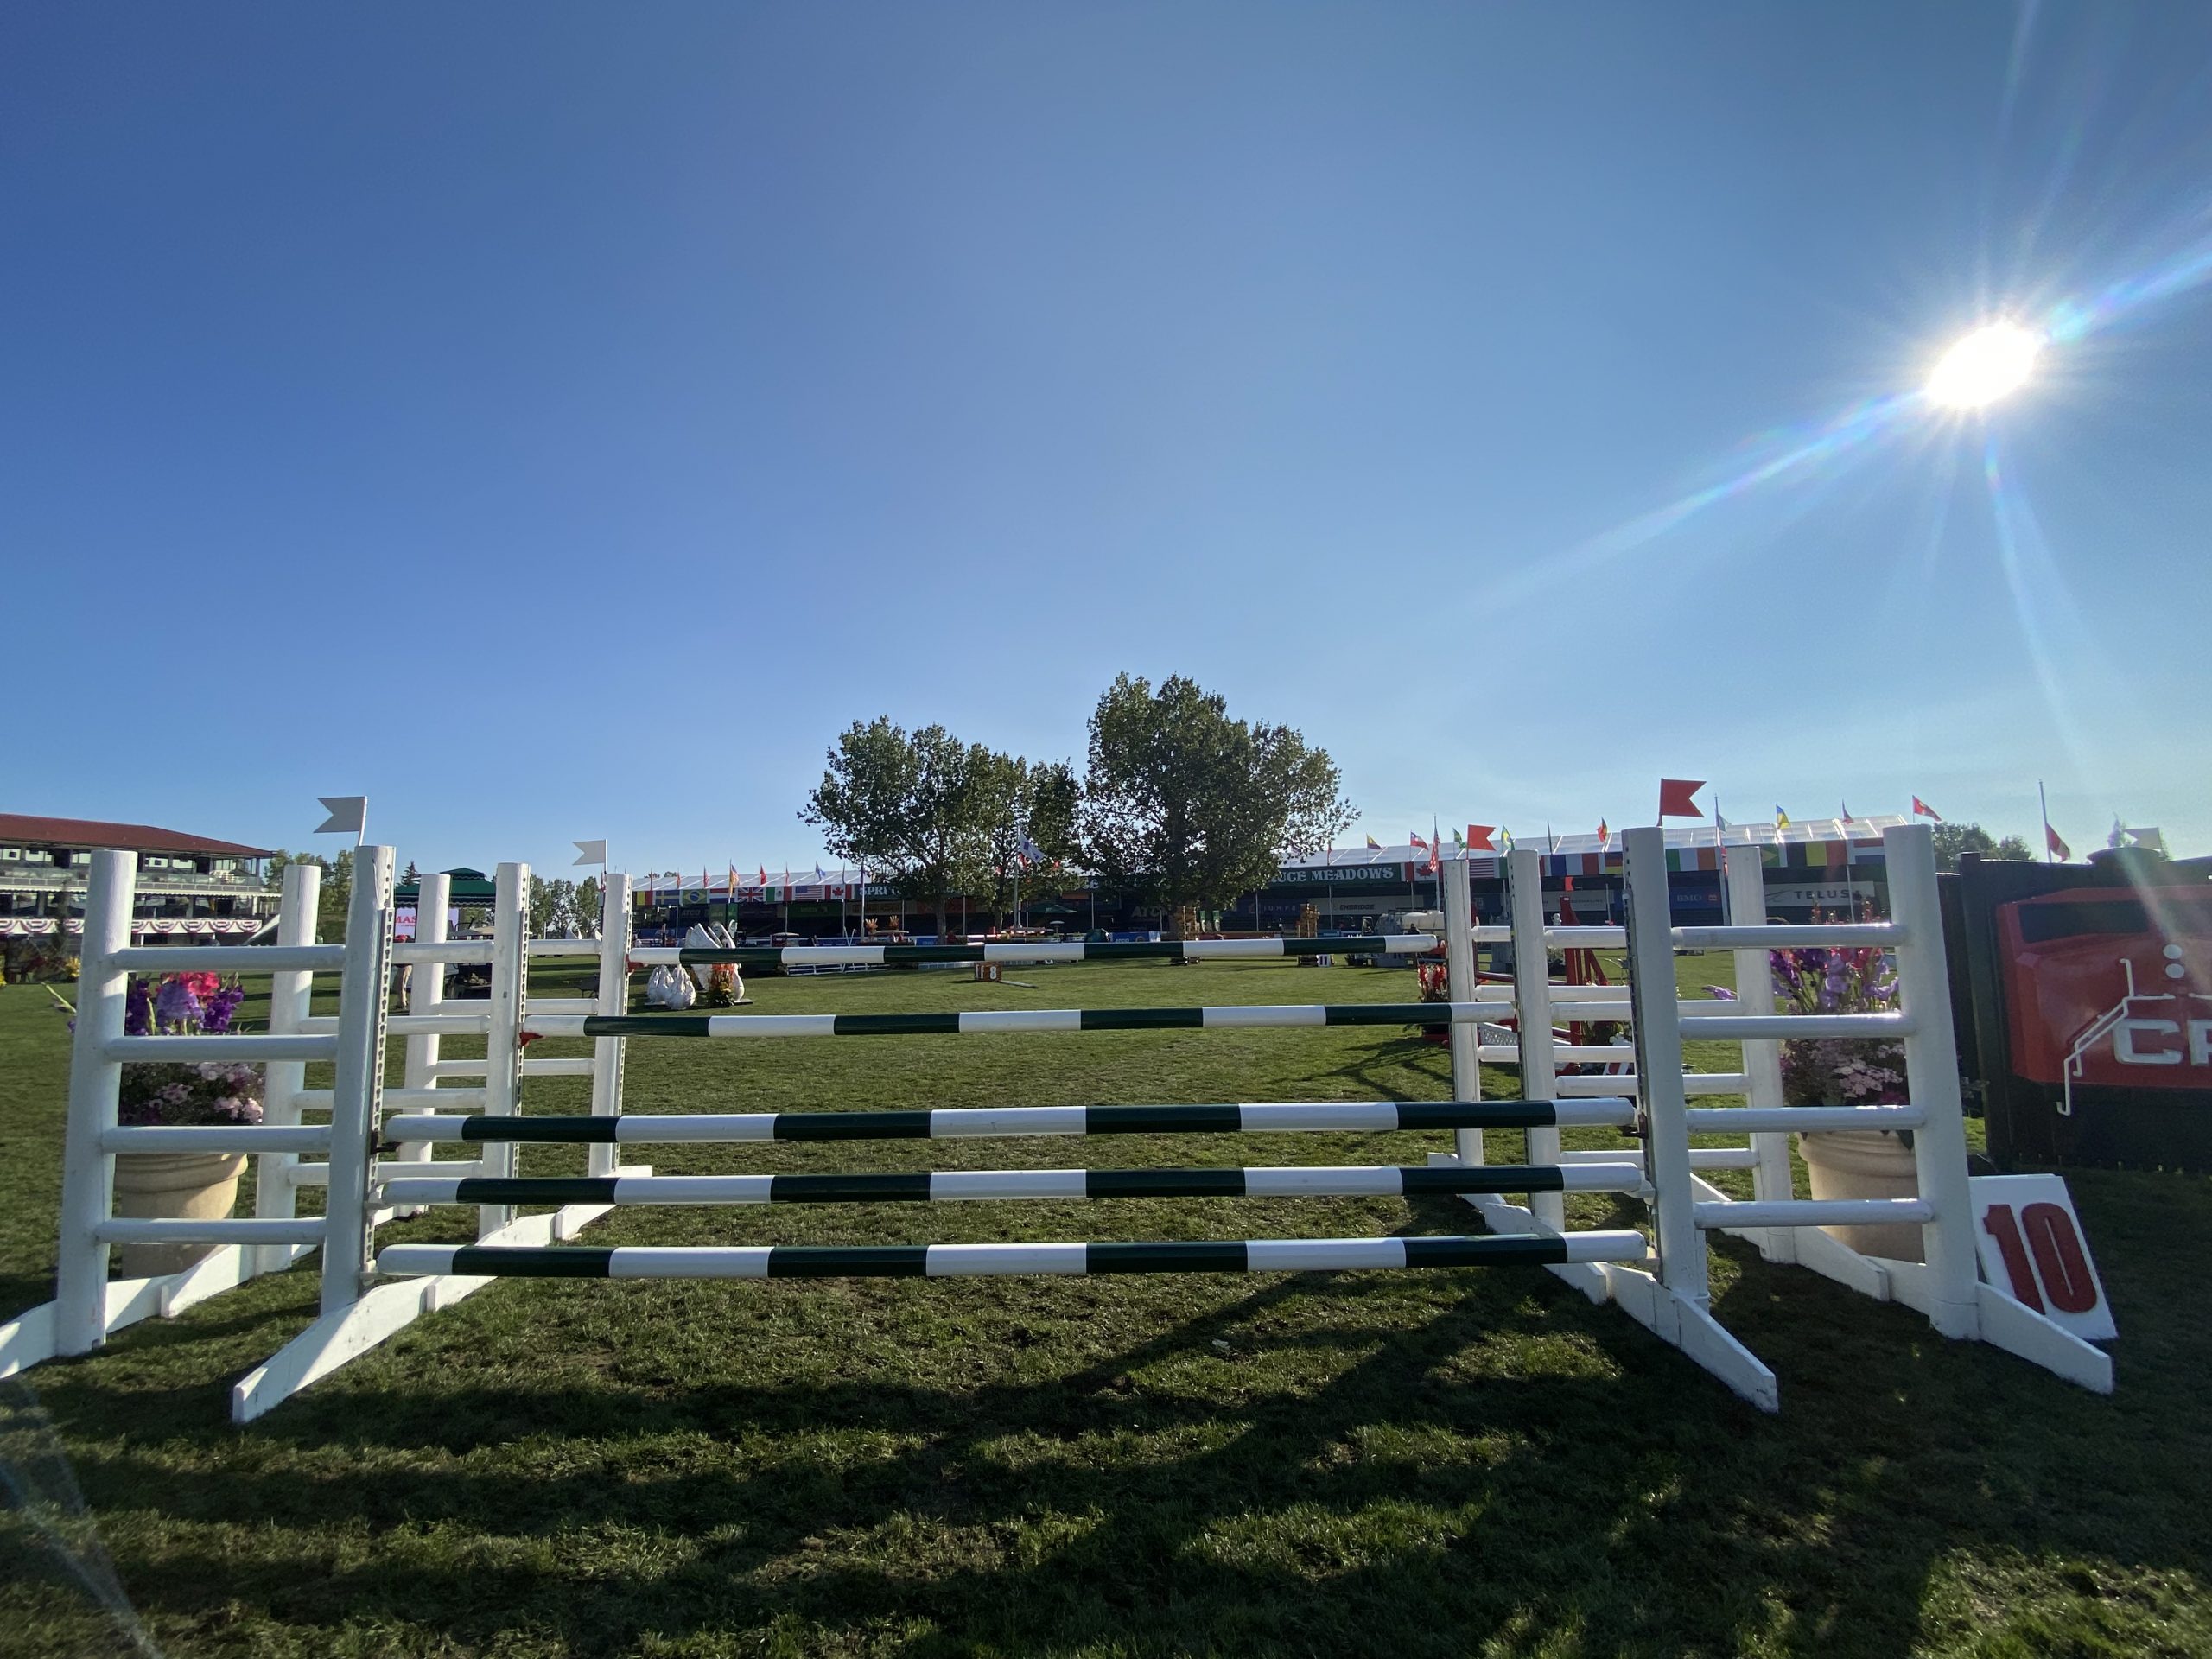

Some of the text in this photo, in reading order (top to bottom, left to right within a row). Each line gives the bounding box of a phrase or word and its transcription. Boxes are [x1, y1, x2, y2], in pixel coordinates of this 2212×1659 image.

[1311, 867, 1395, 882] MEADOWS
[1794, 890, 1850, 899] TELUS
[1982, 1202, 2097, 1315] 10
